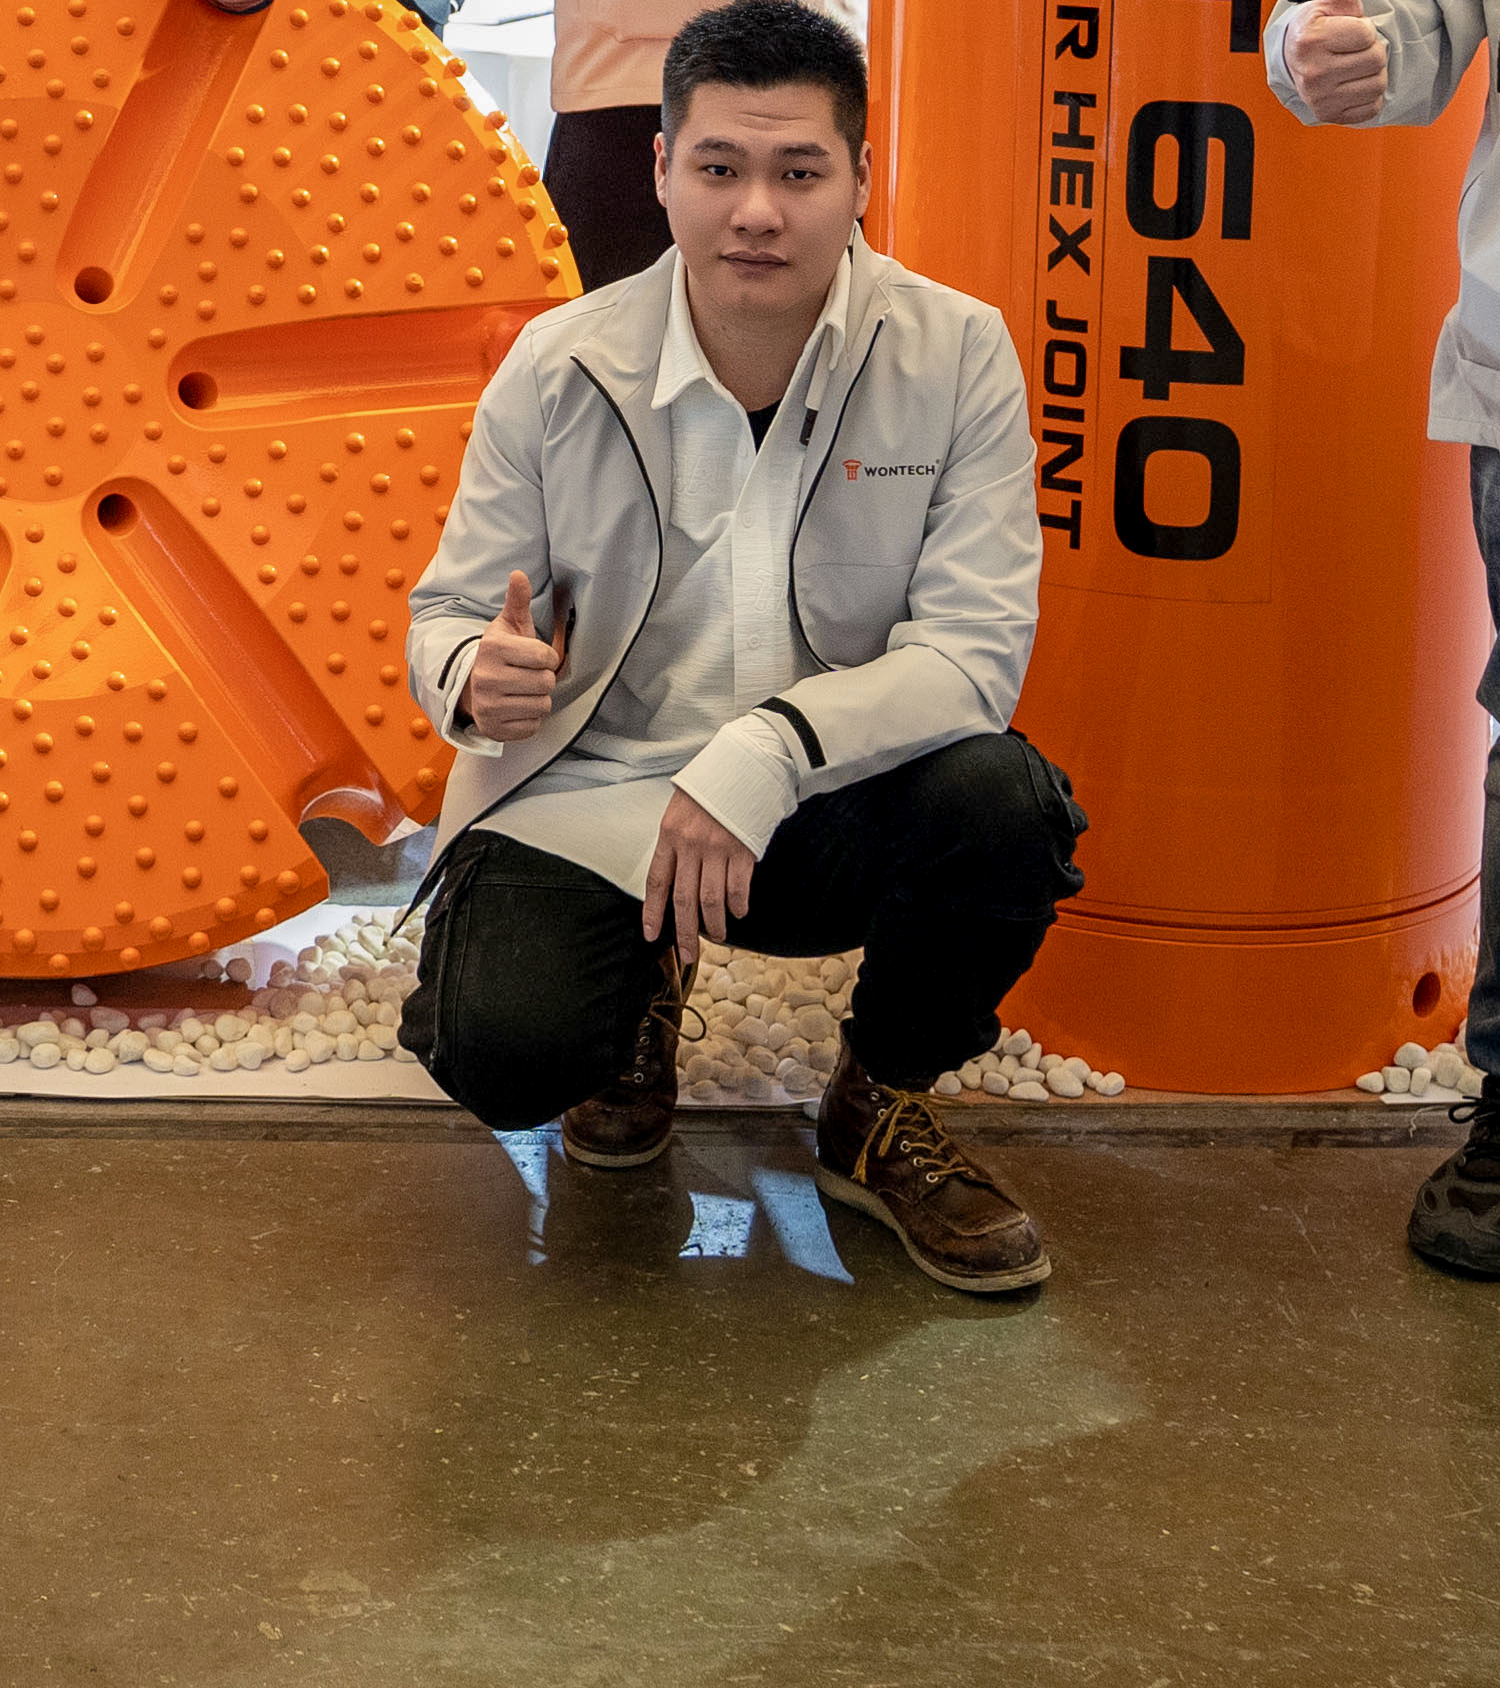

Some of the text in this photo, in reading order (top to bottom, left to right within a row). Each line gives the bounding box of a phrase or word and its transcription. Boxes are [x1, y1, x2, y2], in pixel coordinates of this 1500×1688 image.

[1046, 93, 1098, 275] HEX
[1039, 298, 1087, 550] JOINT
[1114, 100, 1254, 561] 640
[864, 462, 936, 478] WONTECH
